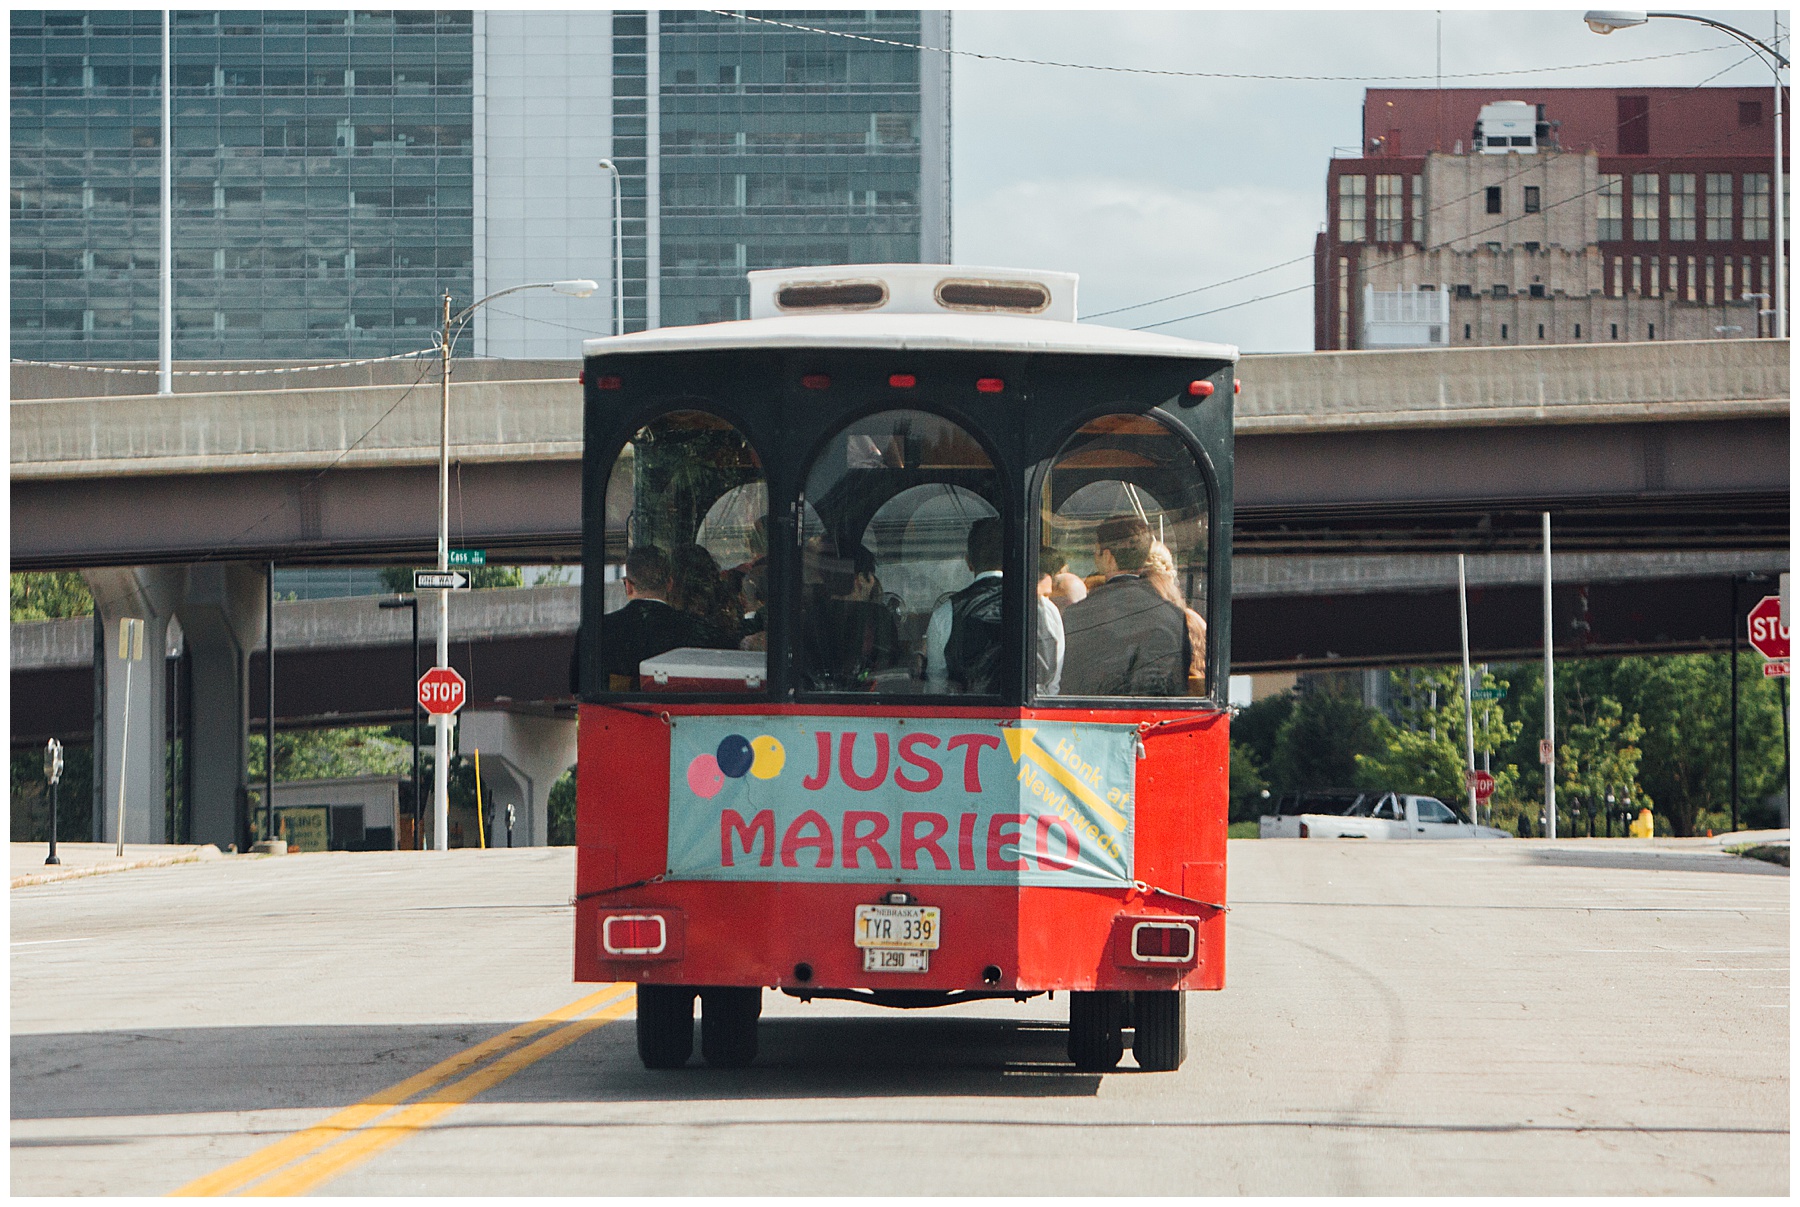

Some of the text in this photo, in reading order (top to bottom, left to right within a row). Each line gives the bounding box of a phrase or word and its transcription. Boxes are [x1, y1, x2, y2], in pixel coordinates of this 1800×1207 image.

[450, 551, 468, 563] Cass
[420, 575, 454, 585] ONE WAY
[421, 682, 461, 701] STOP
[802, 731, 1001, 793] JUST
[1055, 738, 1131, 810] Honk at
[1476, 779, 1493, 792] TOP
[1017, 763, 1122, 859] Newlyweds
[720, 808, 1081, 871] MARRIED
[877, 908, 918, 917] NEBRASKA
[864, 918, 931, 940] TYR 339
[880, 951, 905, 967] 1290
